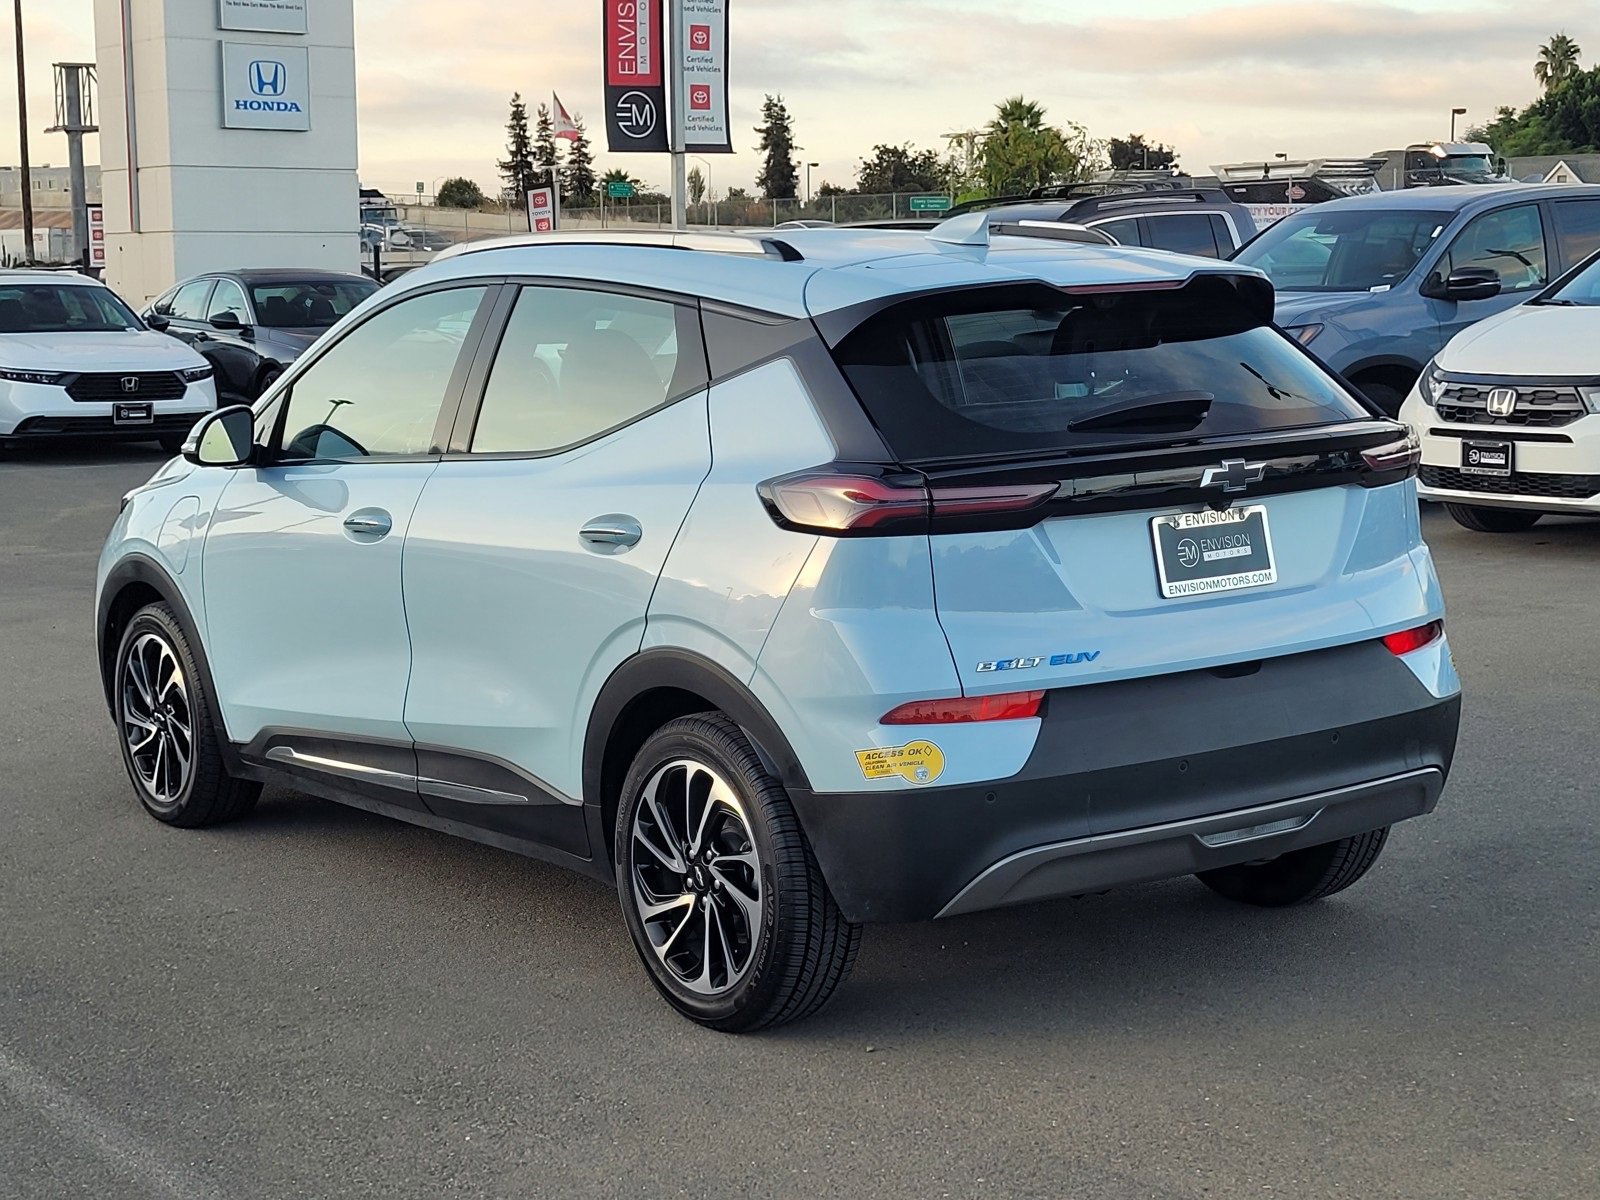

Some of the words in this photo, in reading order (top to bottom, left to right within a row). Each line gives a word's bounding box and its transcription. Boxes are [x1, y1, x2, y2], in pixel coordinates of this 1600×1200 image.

[618, 0, 636, 75] ENVIS
[686, 55, 713, 64] Certified
[696, 65, 721, 73] Vehicles
[234, 99, 302, 112] HONDA
[687, 115, 715, 123] Certified
[1262, 206, 1287, 216] YOUR
[1185, 511, 1235, 526] ENVISION
[1200, 533, 1251, 551] ENVISION
[1207, 548, 1248, 559] MOTORS
[1168, 572, 1273, 595] ENVISIONMOTORS.COM
[976, 656, 1046, 673] BOLT
[1049, 650, 1101, 666] EUV
[864, 749, 904, 761] ACCESS
[907, 748, 922, 756] OK
